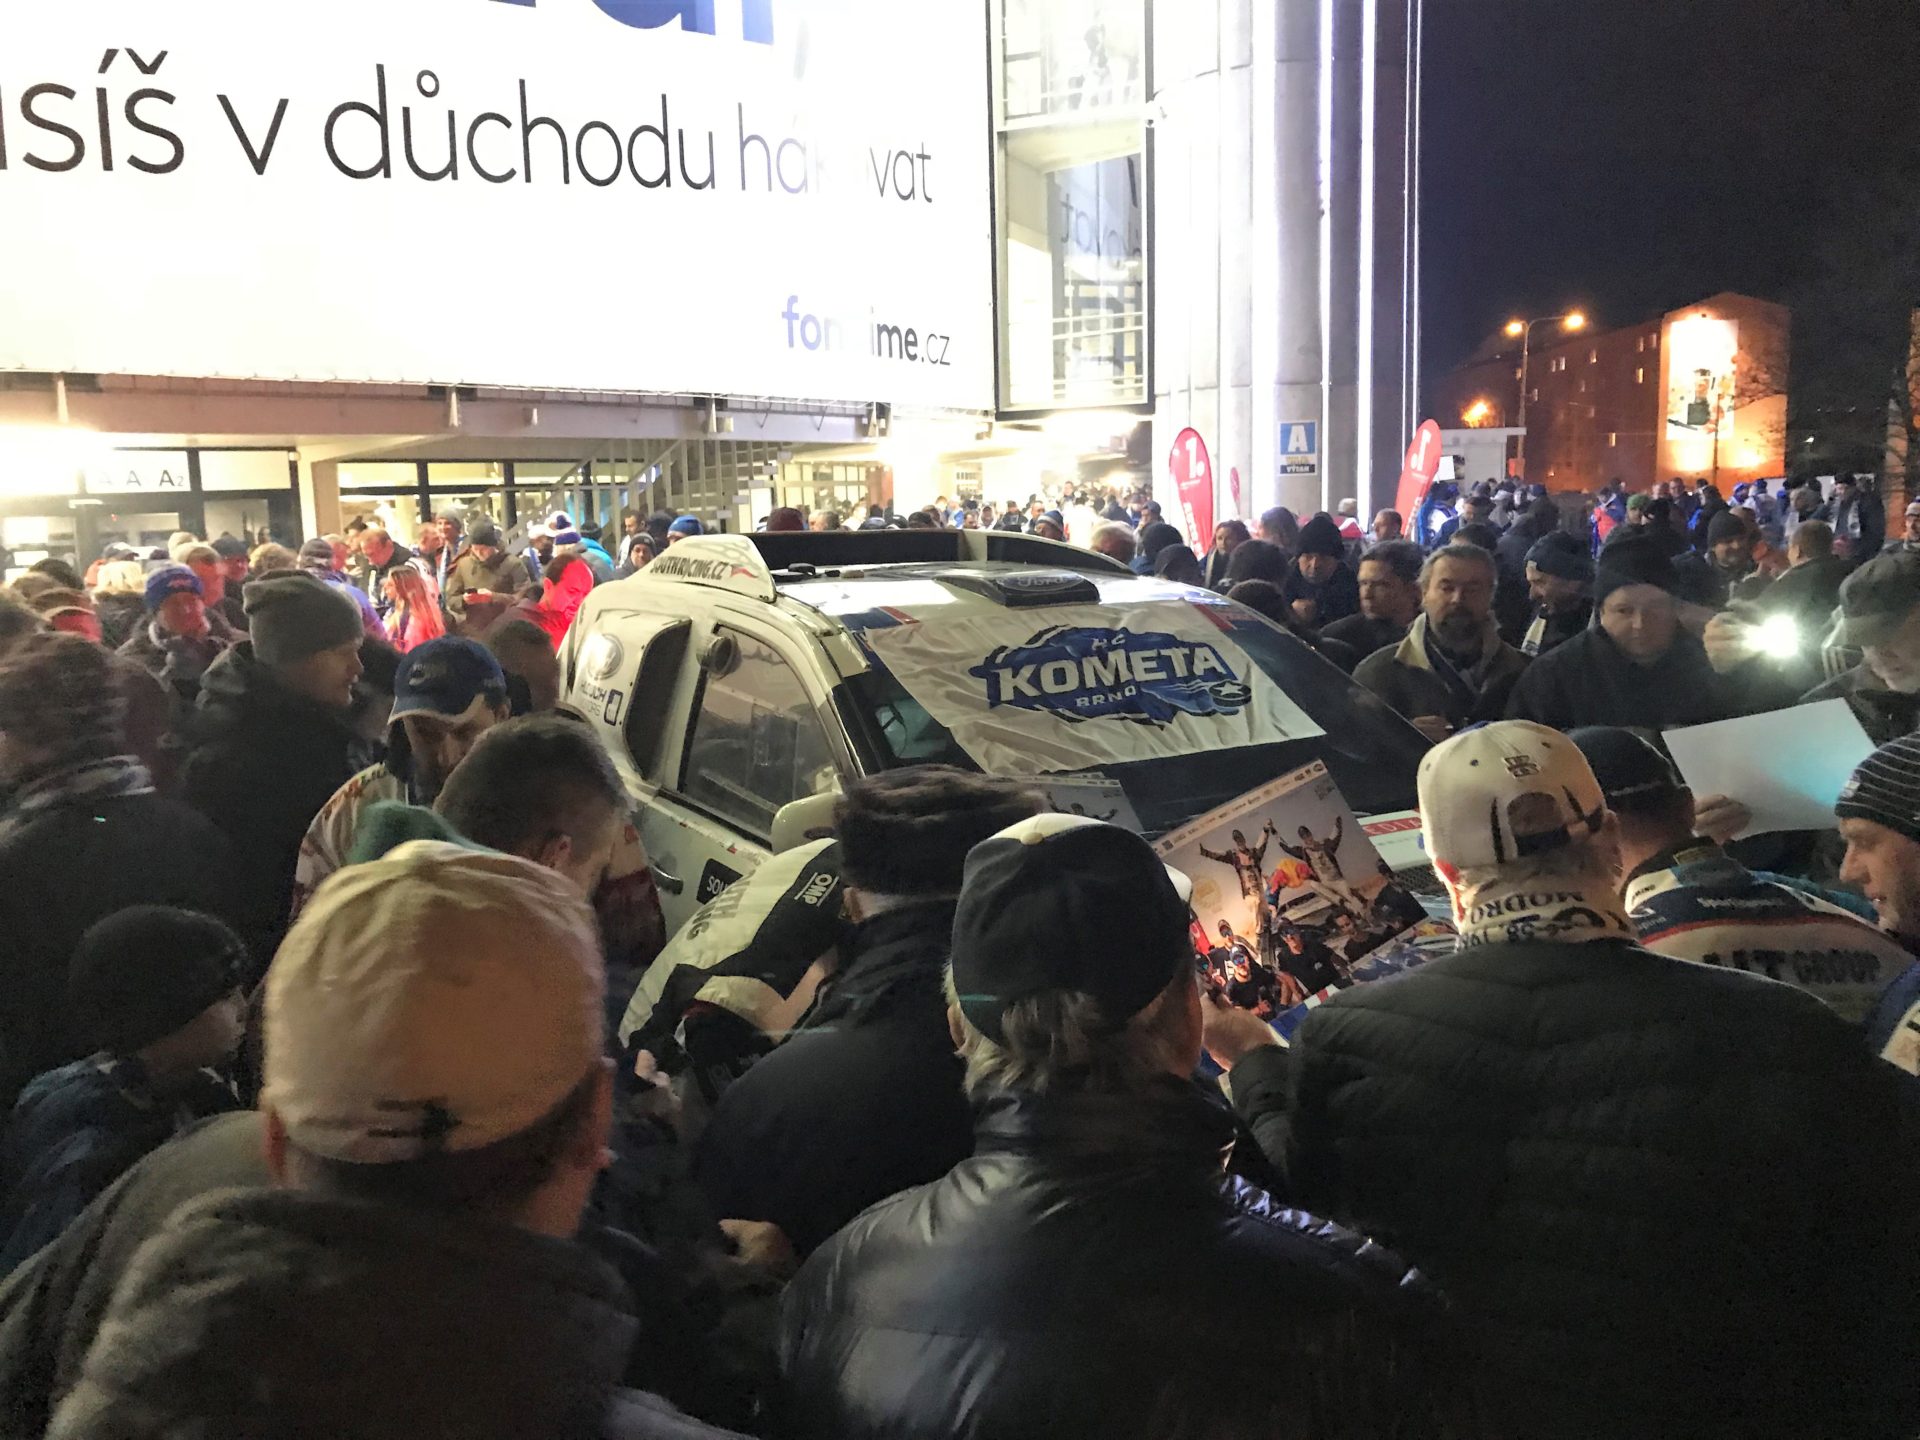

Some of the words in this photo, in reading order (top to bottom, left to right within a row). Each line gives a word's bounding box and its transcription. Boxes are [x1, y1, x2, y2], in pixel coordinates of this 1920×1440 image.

[0, 48, 185, 174] síš
[216, 94, 289, 175] v
[324, 63, 716, 190] důchodu
[1287, 424, 1309, 452] A
[1000, 646, 1226, 702] KOMETA
[1075, 685, 1137, 707] BRNO
[801, 873, 833, 905] OMP
